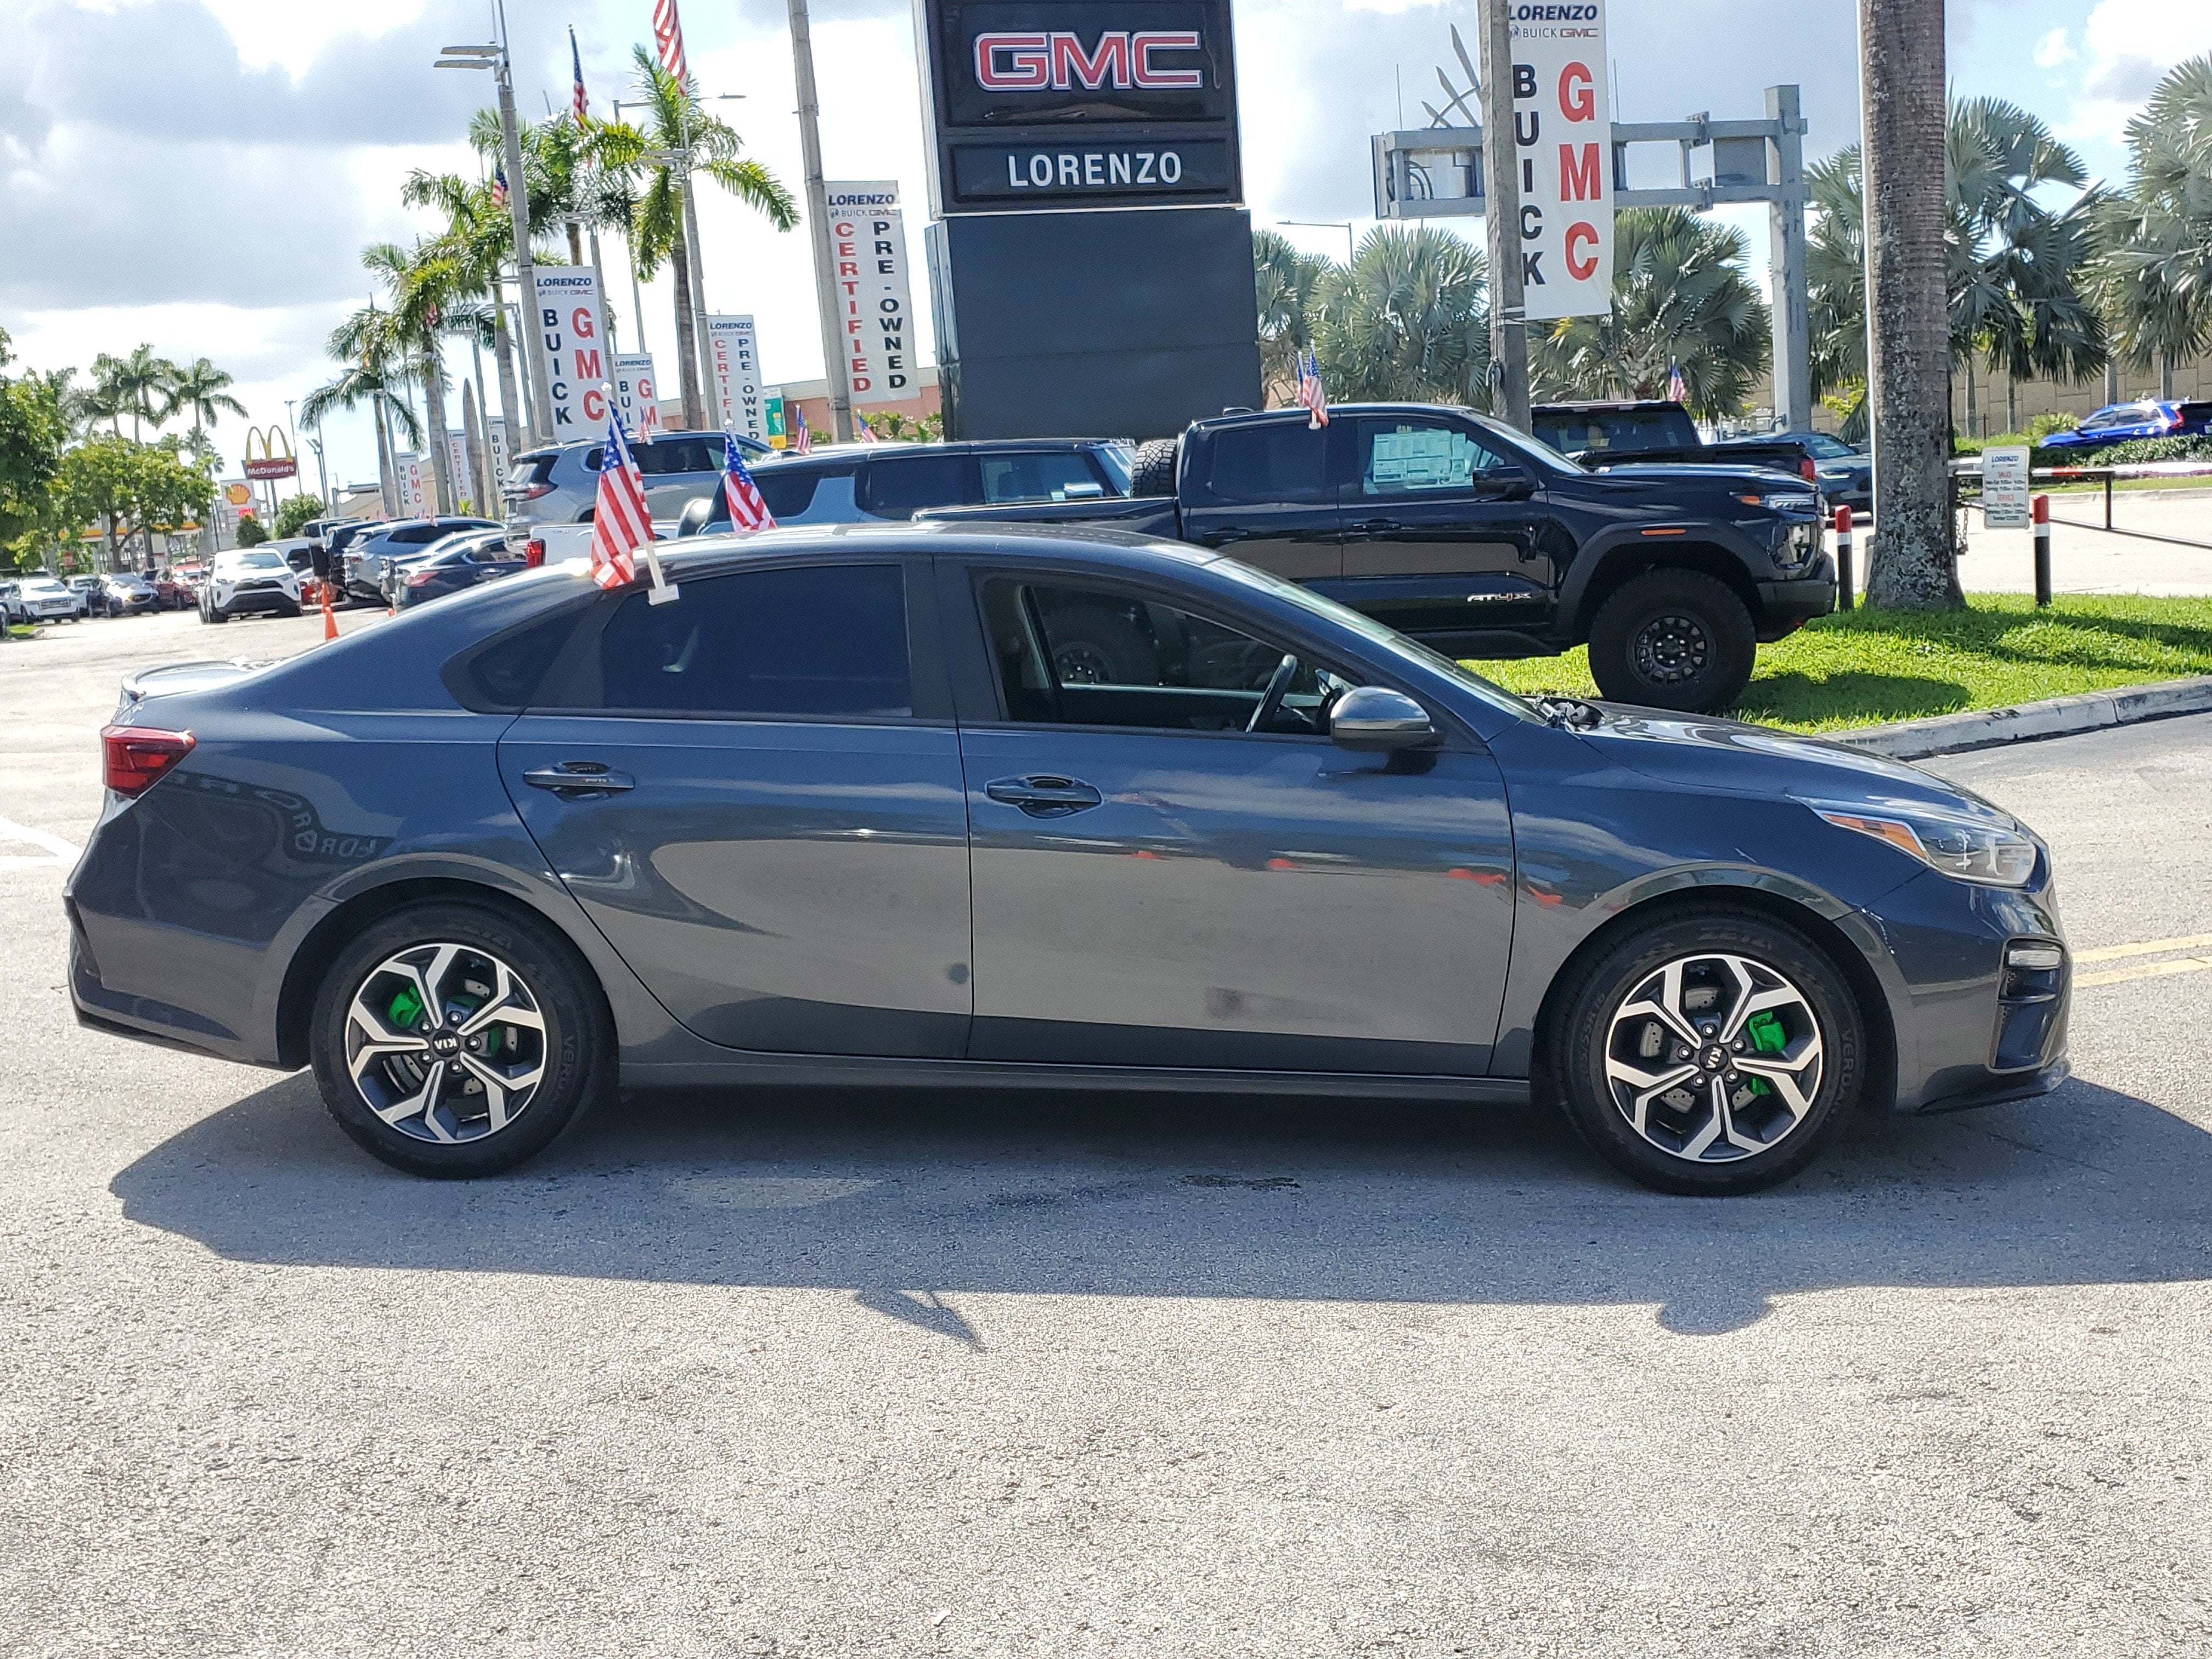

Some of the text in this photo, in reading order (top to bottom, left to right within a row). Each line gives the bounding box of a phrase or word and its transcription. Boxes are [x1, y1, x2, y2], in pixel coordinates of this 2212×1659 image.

[1509, 5, 1598, 20] LORENZO
[1523, 28, 1599, 38] BUICK GMC
[974, 30, 1203, 91] GMC
[1008, 151, 1182, 187] LORENZO
[1513, 64, 1546, 285] BUICK
[1558, 61, 1601, 280] GMC
[828, 194, 895, 206] LORENZO
[841, 209, 867, 217] BUICK
[537, 278, 592, 287] LORENZO
[835, 222, 872, 393] CERTIFIED
[872, 221, 907, 390] PRE-OWNED
[542, 309, 573, 426] BUICK
[571, 307, 605, 421] GMC
[714, 340, 735, 430] CERTIFI
[619, 381, 635, 433] BUI
[638, 379, 658, 426] GM
[247, 465, 295, 476] McDonald's
[492, 435, 504, 488] BUICK
[410, 465, 422, 504] GMC
[1467, 592, 1532, 602] AT4X
[434, 1037, 458, 1049] KIA
[1705, 1047, 1723, 1069] KIA
